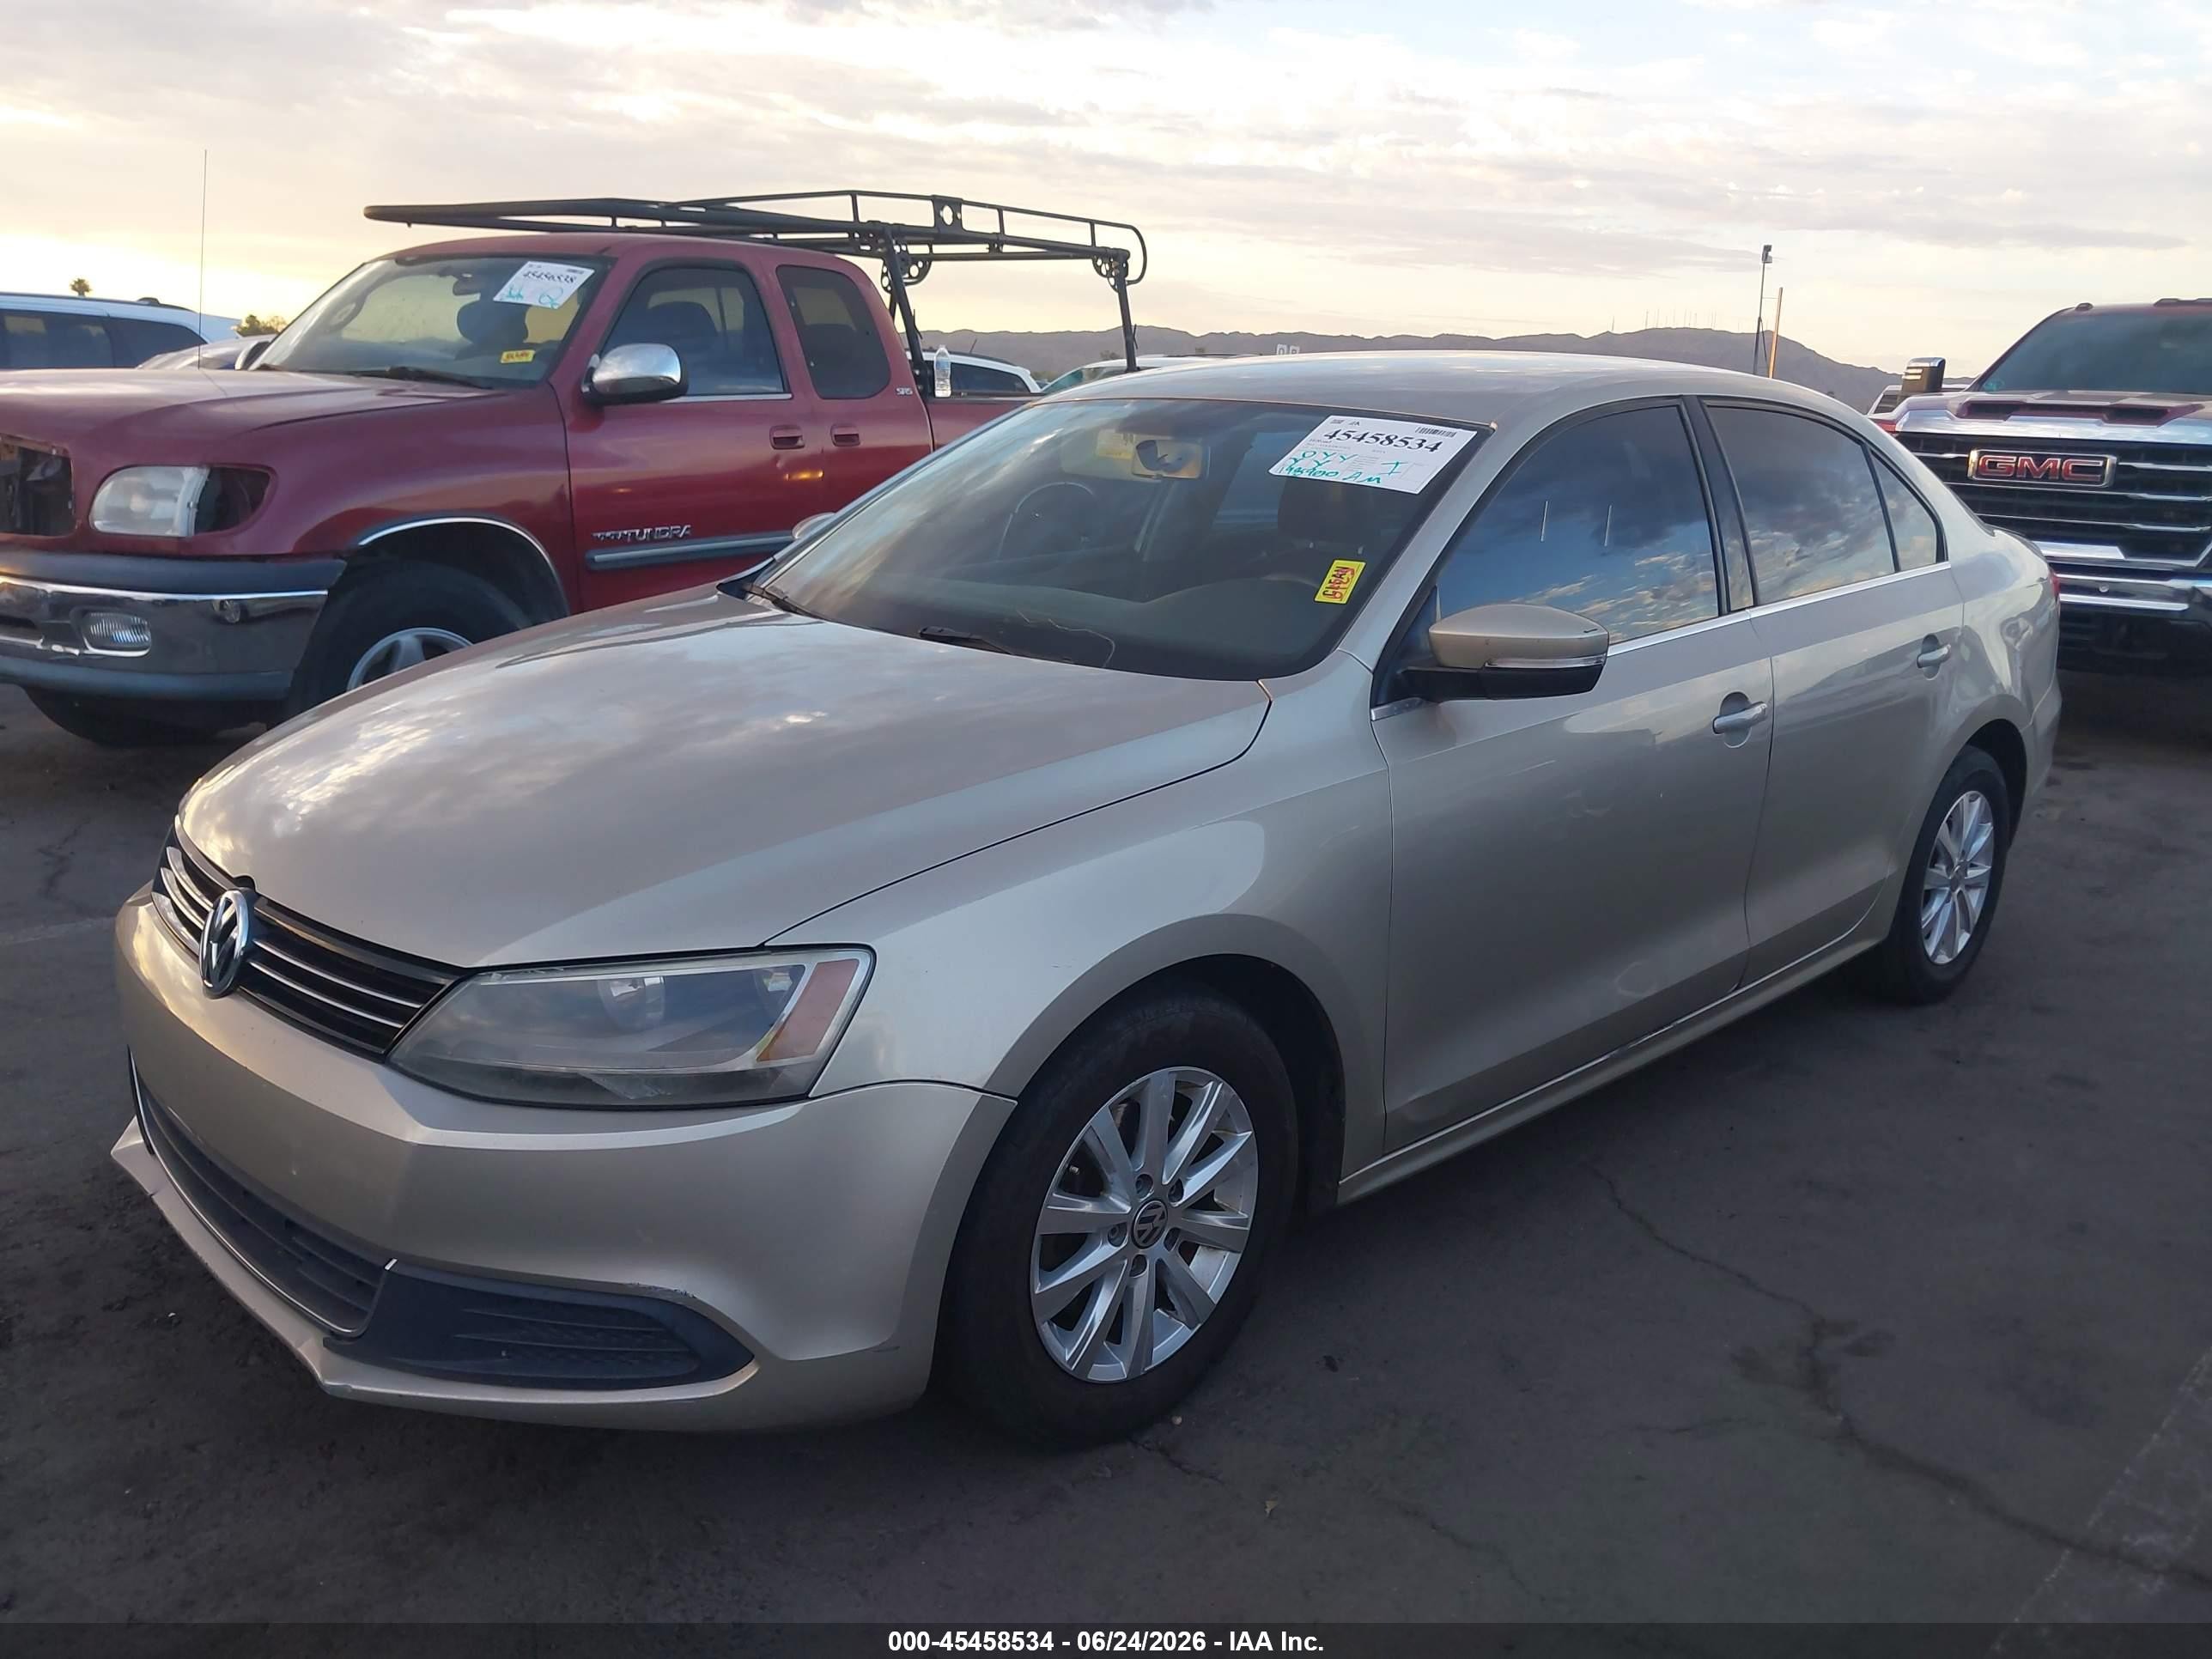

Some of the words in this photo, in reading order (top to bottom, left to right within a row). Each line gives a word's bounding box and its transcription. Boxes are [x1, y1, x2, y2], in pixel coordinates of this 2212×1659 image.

[1324, 429, 1443, 453] 45458534
[1978, 454, 2103, 482] GMC
[625, 525, 691, 542] TUNDRA
